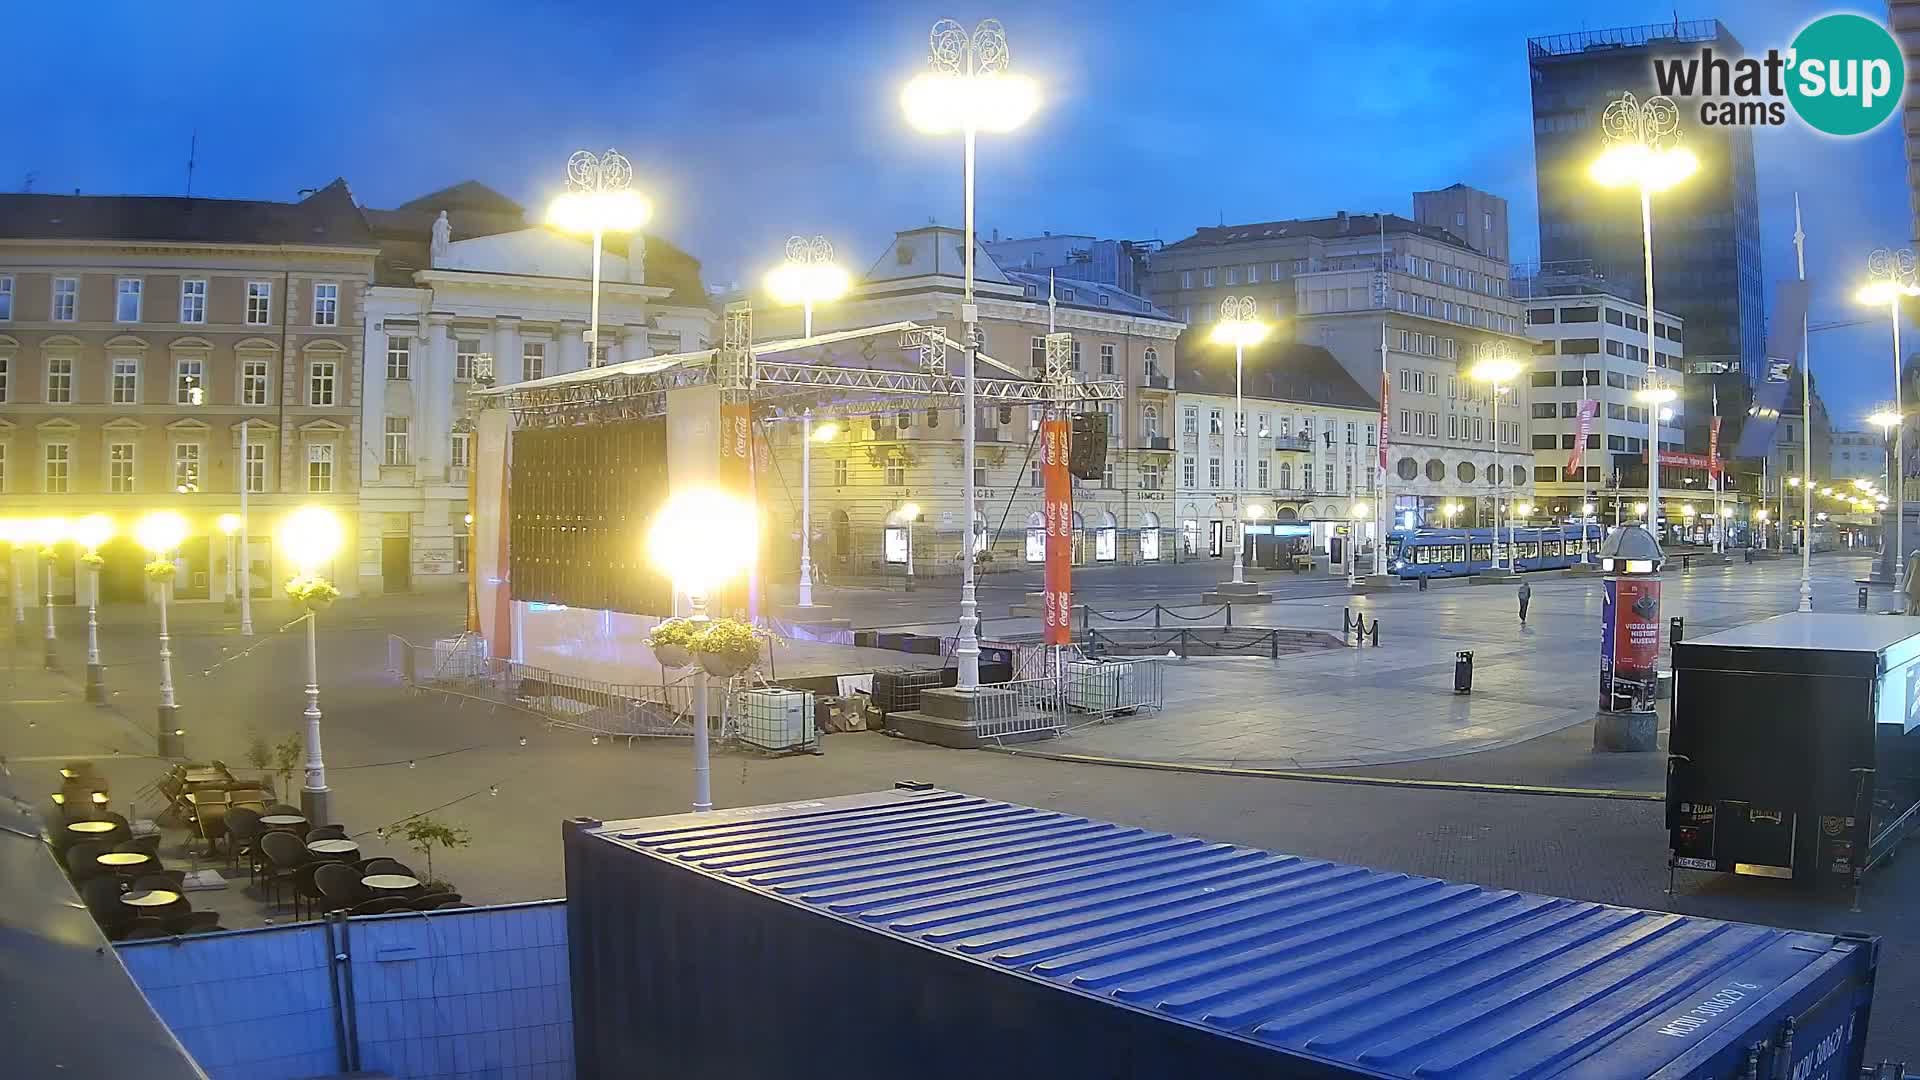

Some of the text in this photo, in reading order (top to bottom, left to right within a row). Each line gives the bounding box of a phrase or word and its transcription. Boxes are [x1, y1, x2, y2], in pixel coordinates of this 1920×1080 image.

[960, 489, 995, 498] SGER
[1657, 1015, 1708, 1038] MCDU
[1690, 989, 1745, 1017] 300629
